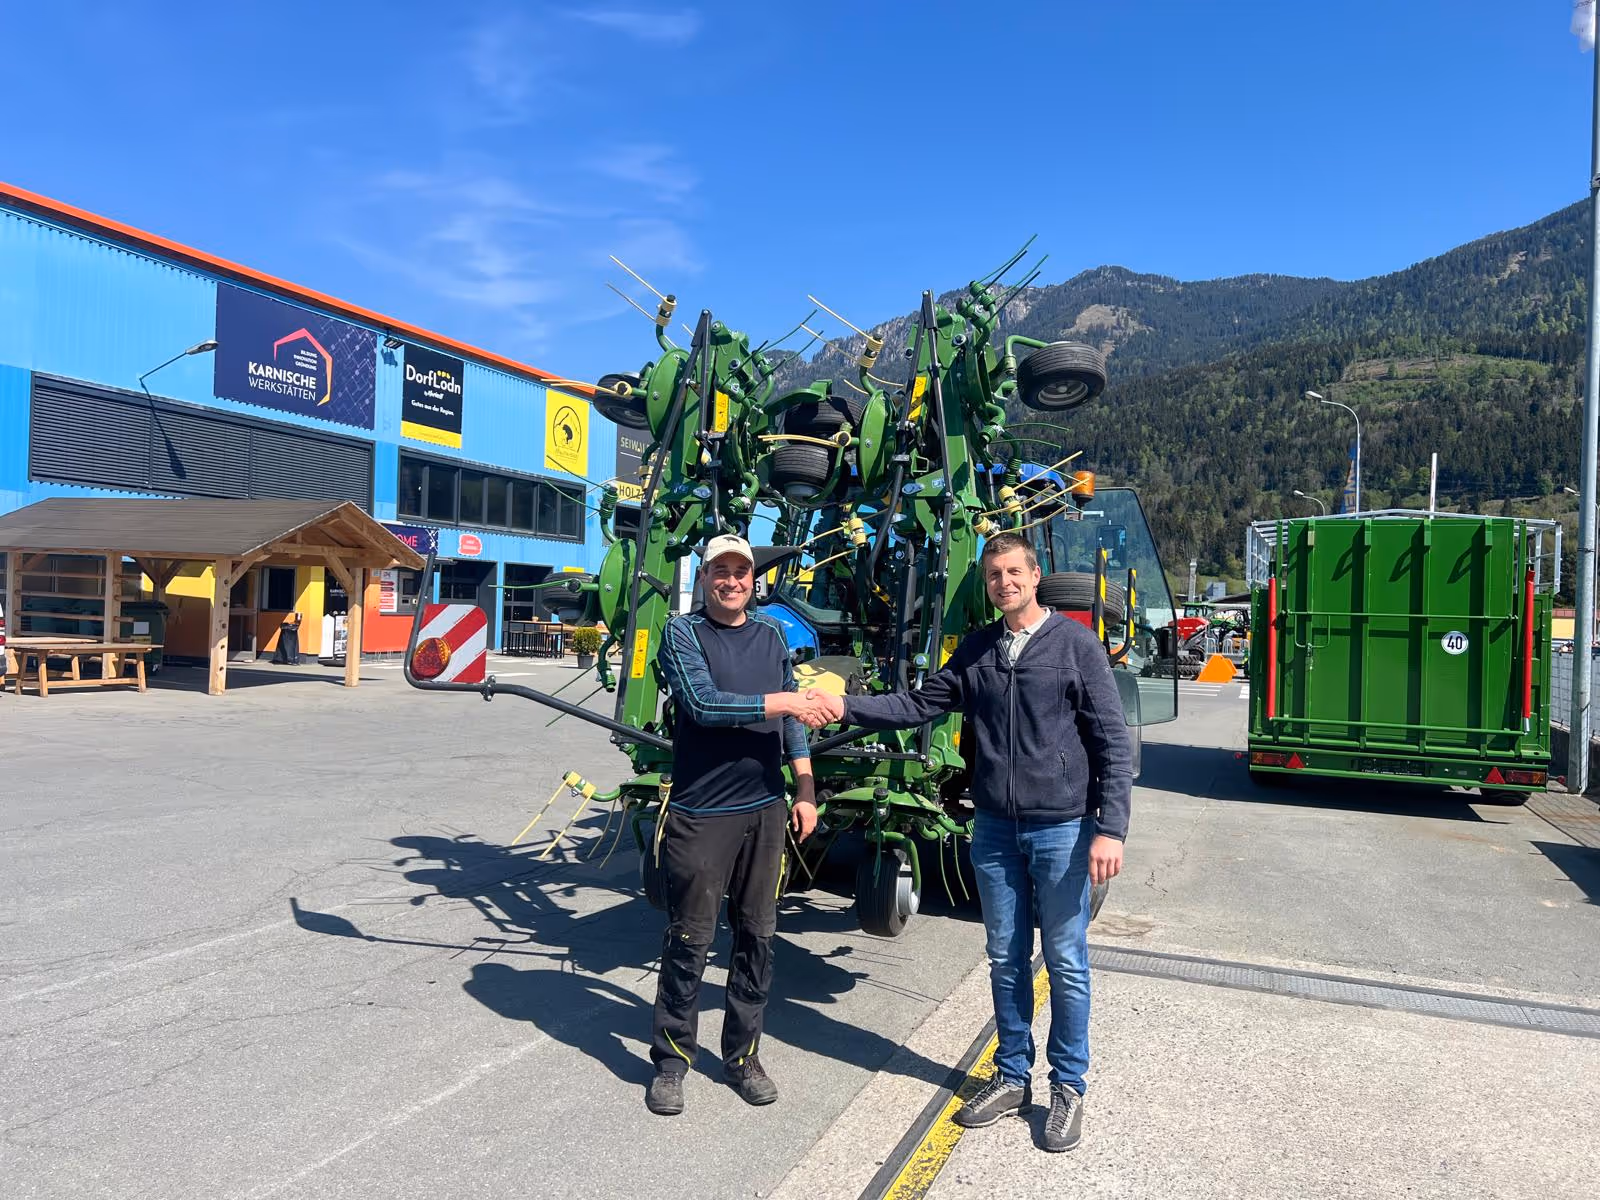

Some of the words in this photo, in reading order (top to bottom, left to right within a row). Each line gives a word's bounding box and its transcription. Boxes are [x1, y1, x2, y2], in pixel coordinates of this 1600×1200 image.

[248, 361, 317, 389] KARNISCHE
[248, 376, 316, 401] WERKSTÄTTEN
[1447, 635, 1463, 650] 40
